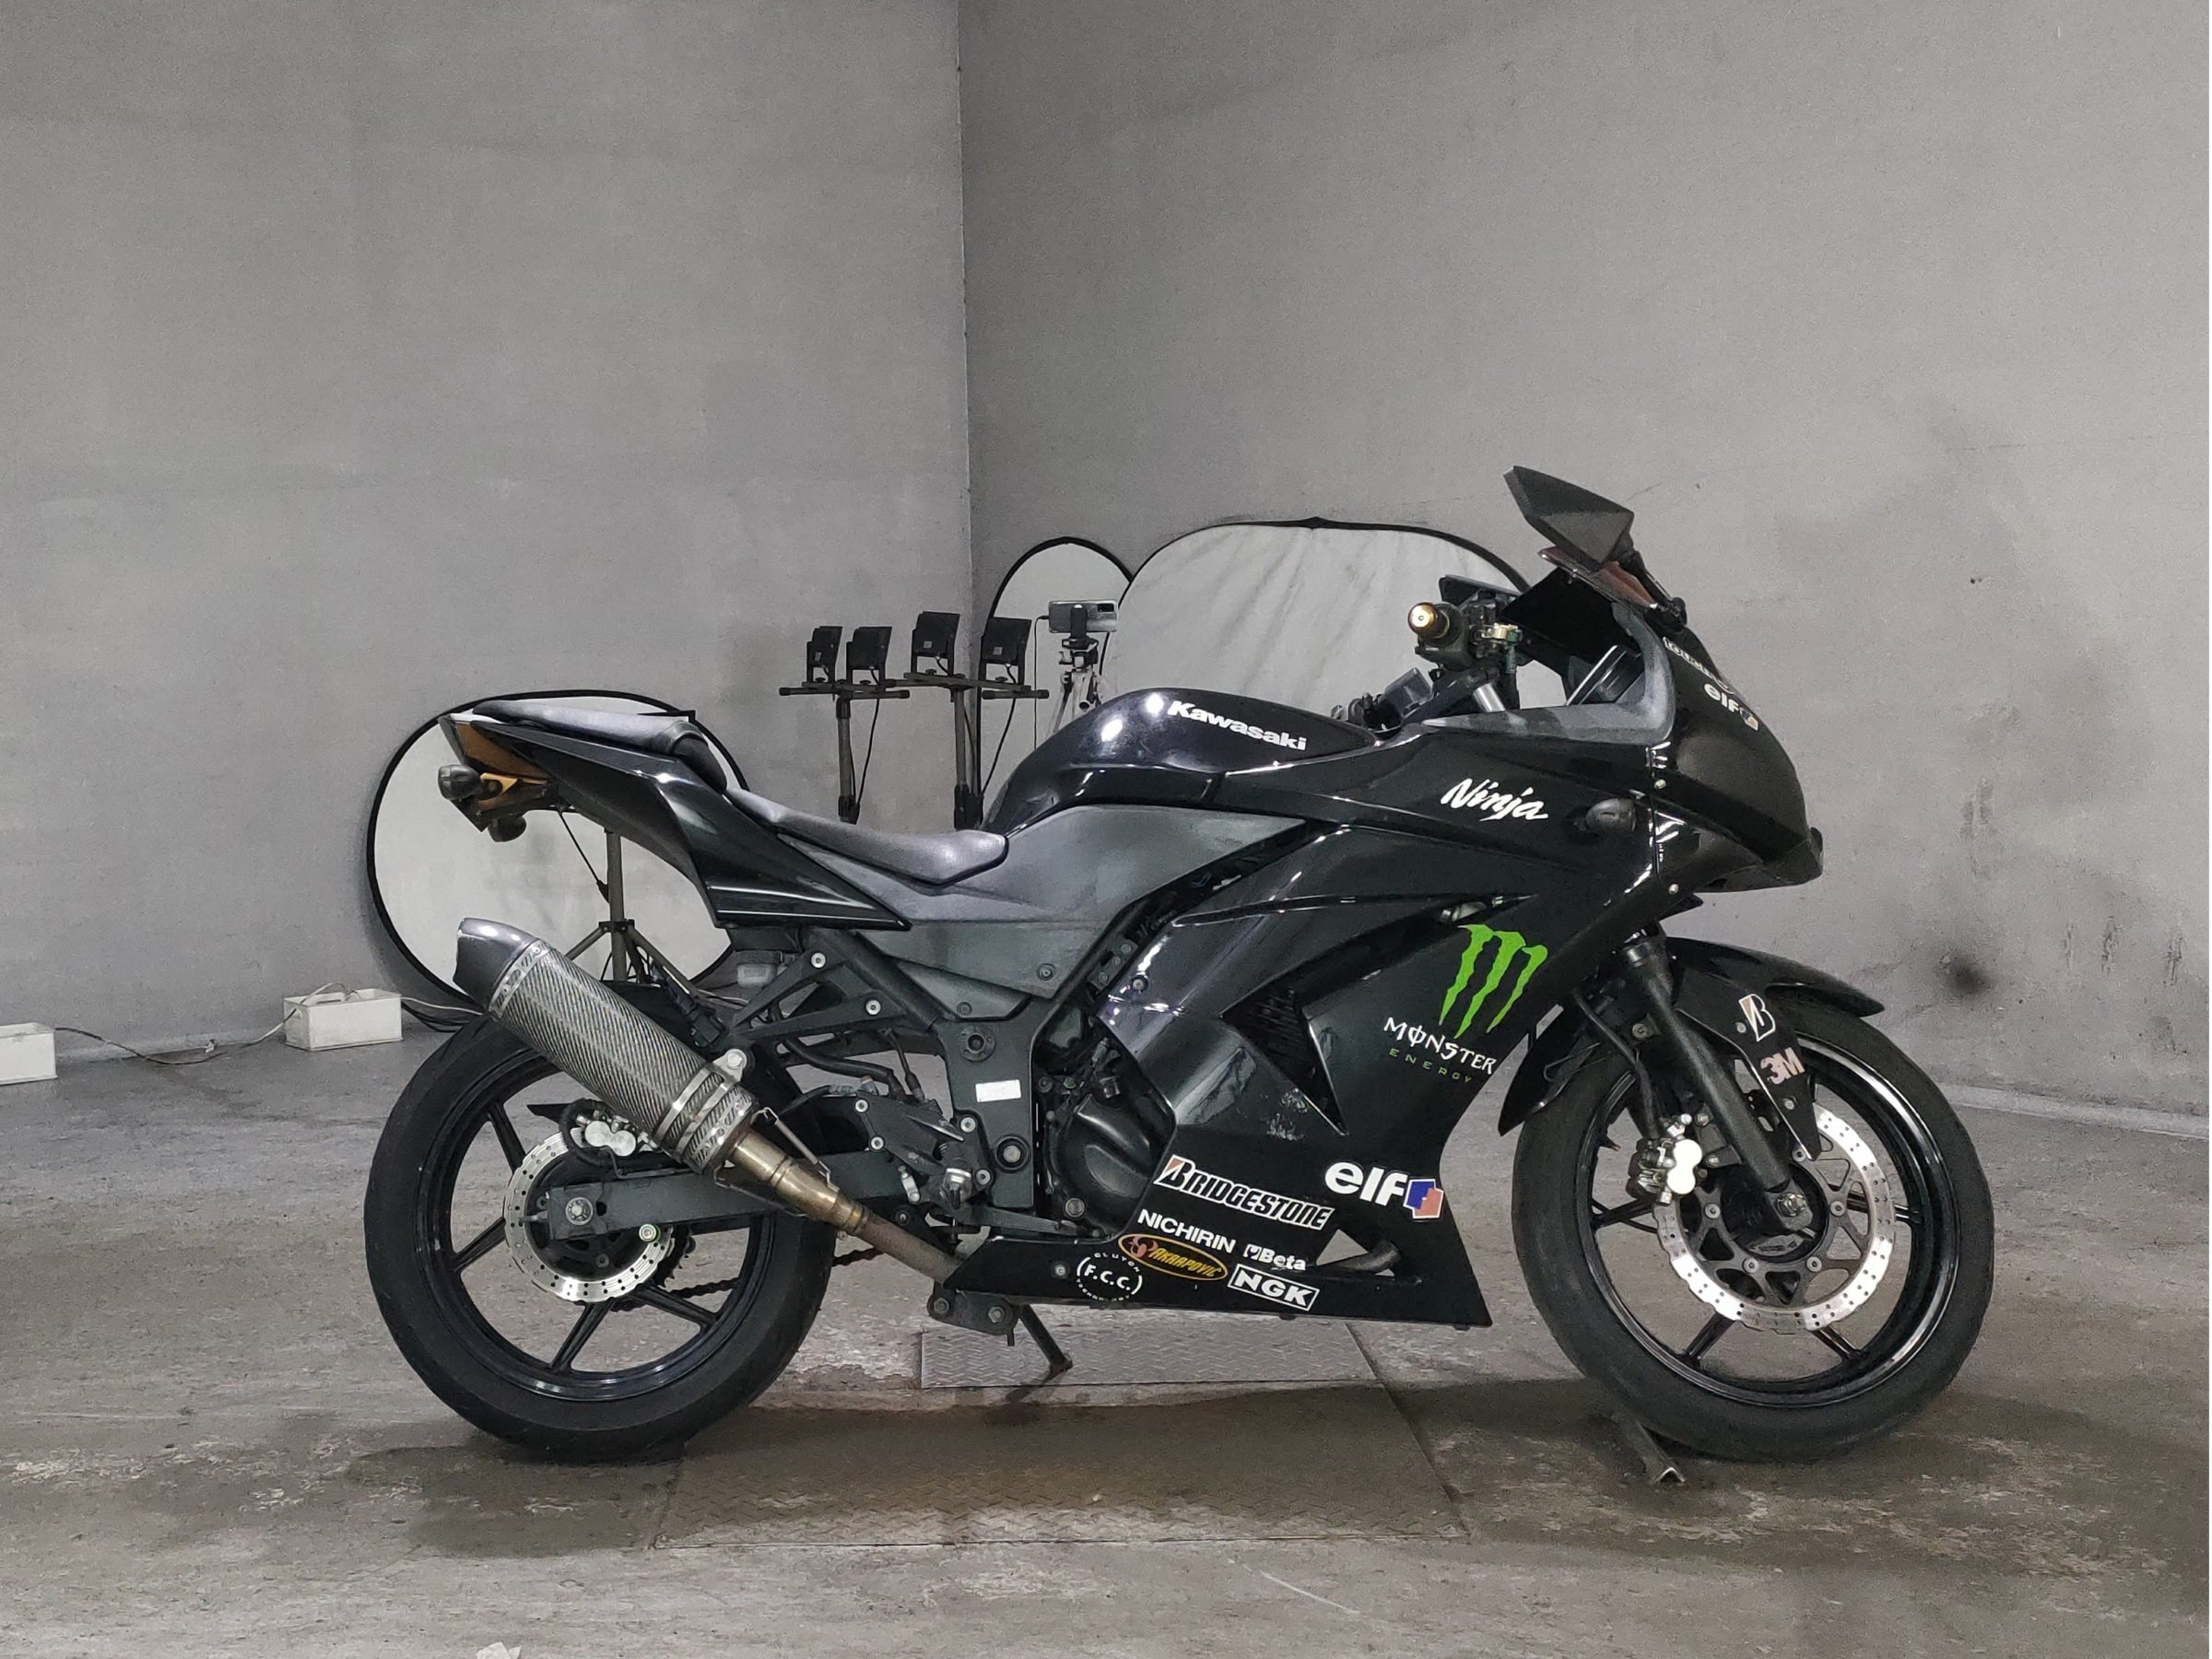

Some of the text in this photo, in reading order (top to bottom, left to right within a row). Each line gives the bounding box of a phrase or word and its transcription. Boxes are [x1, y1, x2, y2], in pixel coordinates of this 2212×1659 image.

[1704, 683, 1739, 712] elf
[1167, 699, 1307, 751] Kawasaki
[1440, 778, 1549, 822] Ninja
[1389, 1047, 1473, 1085] ENERGY
[1760, 1047, 1806, 1085] 3M
[1153, 1154, 1335, 1231] BRIDGESTONE
[1324, 1161, 1409, 1206] elf
[1137, 1208, 1237, 1254] NICHIRIN
[1259, 1247, 1307, 1272] Beta
[1234, 1269, 1312, 1307] NGK
